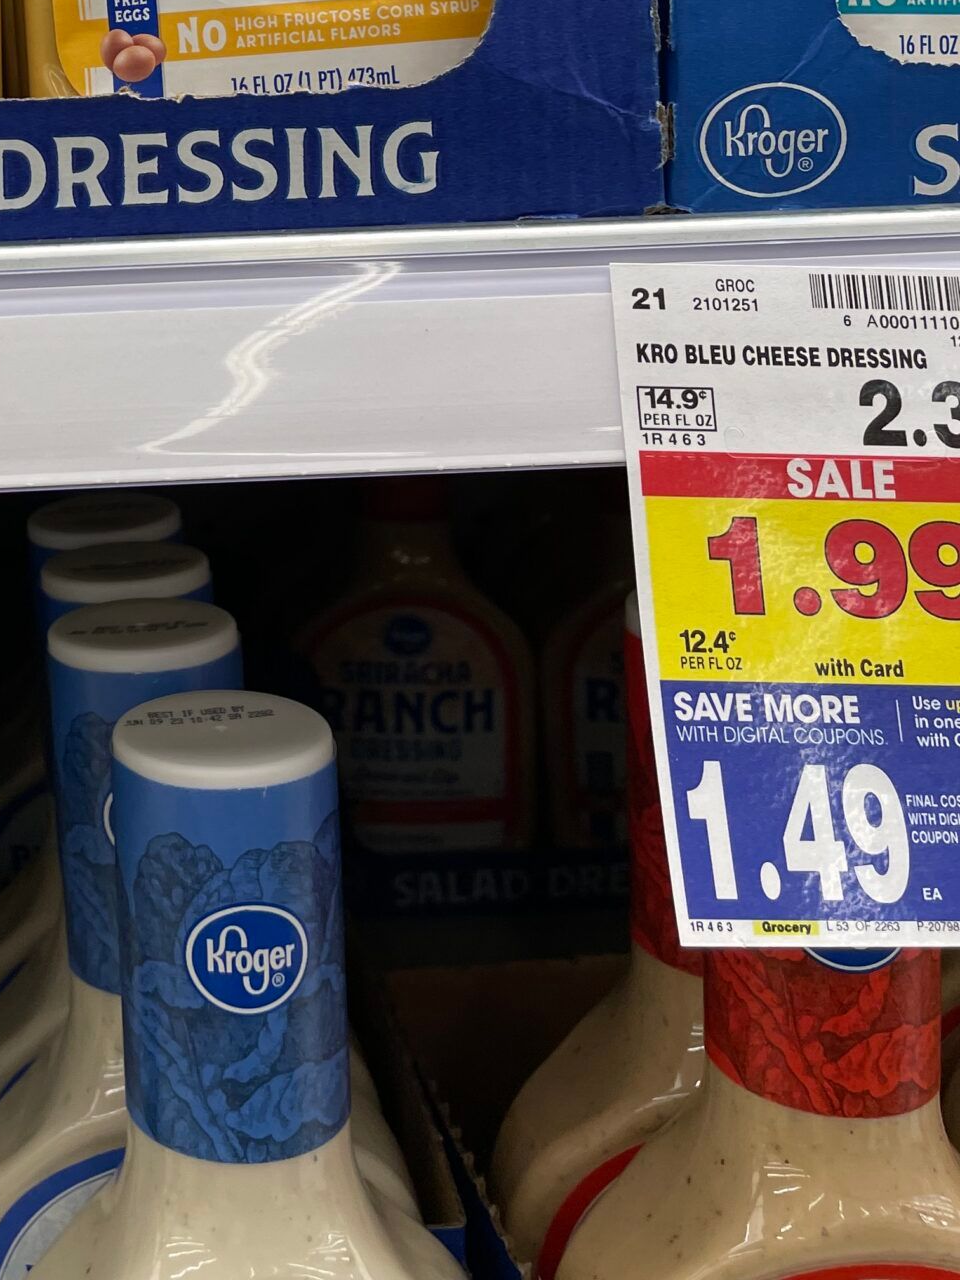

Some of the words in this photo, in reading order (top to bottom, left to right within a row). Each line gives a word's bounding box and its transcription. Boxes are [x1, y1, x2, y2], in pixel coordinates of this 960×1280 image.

[115, 7, 150, 23] EGGS
[235, 16, 278, 31] HIGH
[284, 7, 371, 28] FRUCTOSE
[377, 3, 424, 20] CORN
[430, 0, 480, 16] SYRUP
[177, 16, 227, 54] NO
[236, 30, 325, 49] ARTIFICIAL
[330, 23, 401, 40] FLAVORS
[898, 34, 915, 55] 16
[920, 35, 935, 54] FL
[939, 35, 959, 55] OZ
[318, 68, 342, 91] PT)
[347, 65, 400, 86] 473mL
[725, 104, 829, 178] Kroger
[715, 279, 755, 293] GROC
[631, 287, 666, 310] 21
[692, 297, 758, 312] 2101251
[636, 343, 678, 364] KRO
[685, 344, 736, 366] BLEU
[742, 346, 821, 367] CHEESE
[827, 347, 927, 369] DRESSING
[644, 414, 671, 426] PER
[675, 414, 690, 426] FL
[695, 414, 713, 427] OZ
[786, 458, 896, 500] SALE
[680, 657, 705, 669] PER
[709, 657, 723, 670] FL
[726, 657, 742, 670] OZ
[815, 657, 855, 677] with
[860, 659, 904, 678] Card
[147, 711, 173, 719] BEST
[182, 709, 192, 717] IF
[200, 707, 226, 716] USED
[673, 691, 754, 722] SAVE
[764, 694, 860, 725] MORE
[912, 695, 941, 710] Use
[914, 714, 929, 728] in
[676, 725, 718, 742] WITH
[724, 726, 789, 744] DIGITAL
[793, 727, 888, 746] COUPONS.
[916, 733, 950, 747] with
[905, 794, 938, 808] FINAL
[908, 813, 937, 825] WITH
[686, 760, 910, 904] 1.49
[911, 831, 959, 844] COUPON
[922, 887, 943, 901] EA
[761, 920, 812, 933] Grocery
[875, 921, 900, 932] 2263
[206, 924, 295, 995] Kroger
